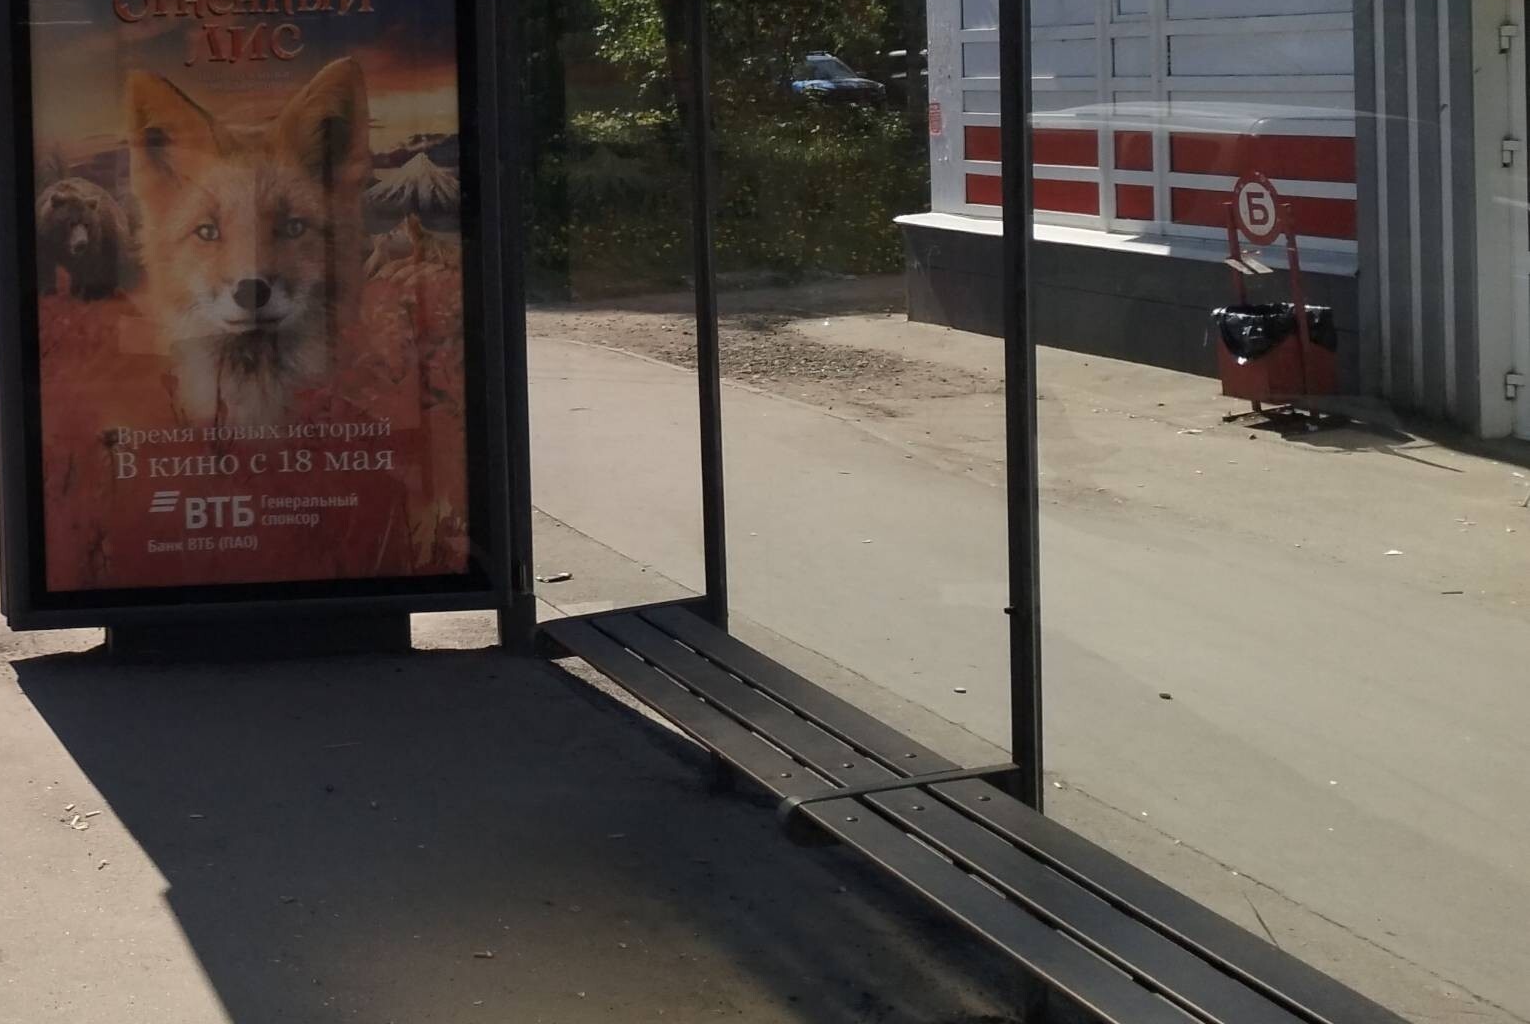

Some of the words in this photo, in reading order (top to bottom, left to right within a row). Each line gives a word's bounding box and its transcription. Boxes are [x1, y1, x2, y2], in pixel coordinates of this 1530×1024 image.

[1246, 192, 1270, 225] Б
[117, 425, 195, 449] Время
[203, 424, 280, 441] новых
[288, 417, 392, 443] историй
[116, 452, 138, 479] В
[149, 452, 239, 478] кино
[250, 452, 268, 474] с
[278, 449, 313, 473] 18
[326, 450, 395, 472] мая
[185, 495, 256, 529] ВТБ
[261, 493, 359, 509] Генеральный
[261, 512, 320, 527] спонсор
[147, 538, 183, 553] Банк
[188, 537, 214, 551] ВТБ
[218, 535, 258, 552] (ПАО)
